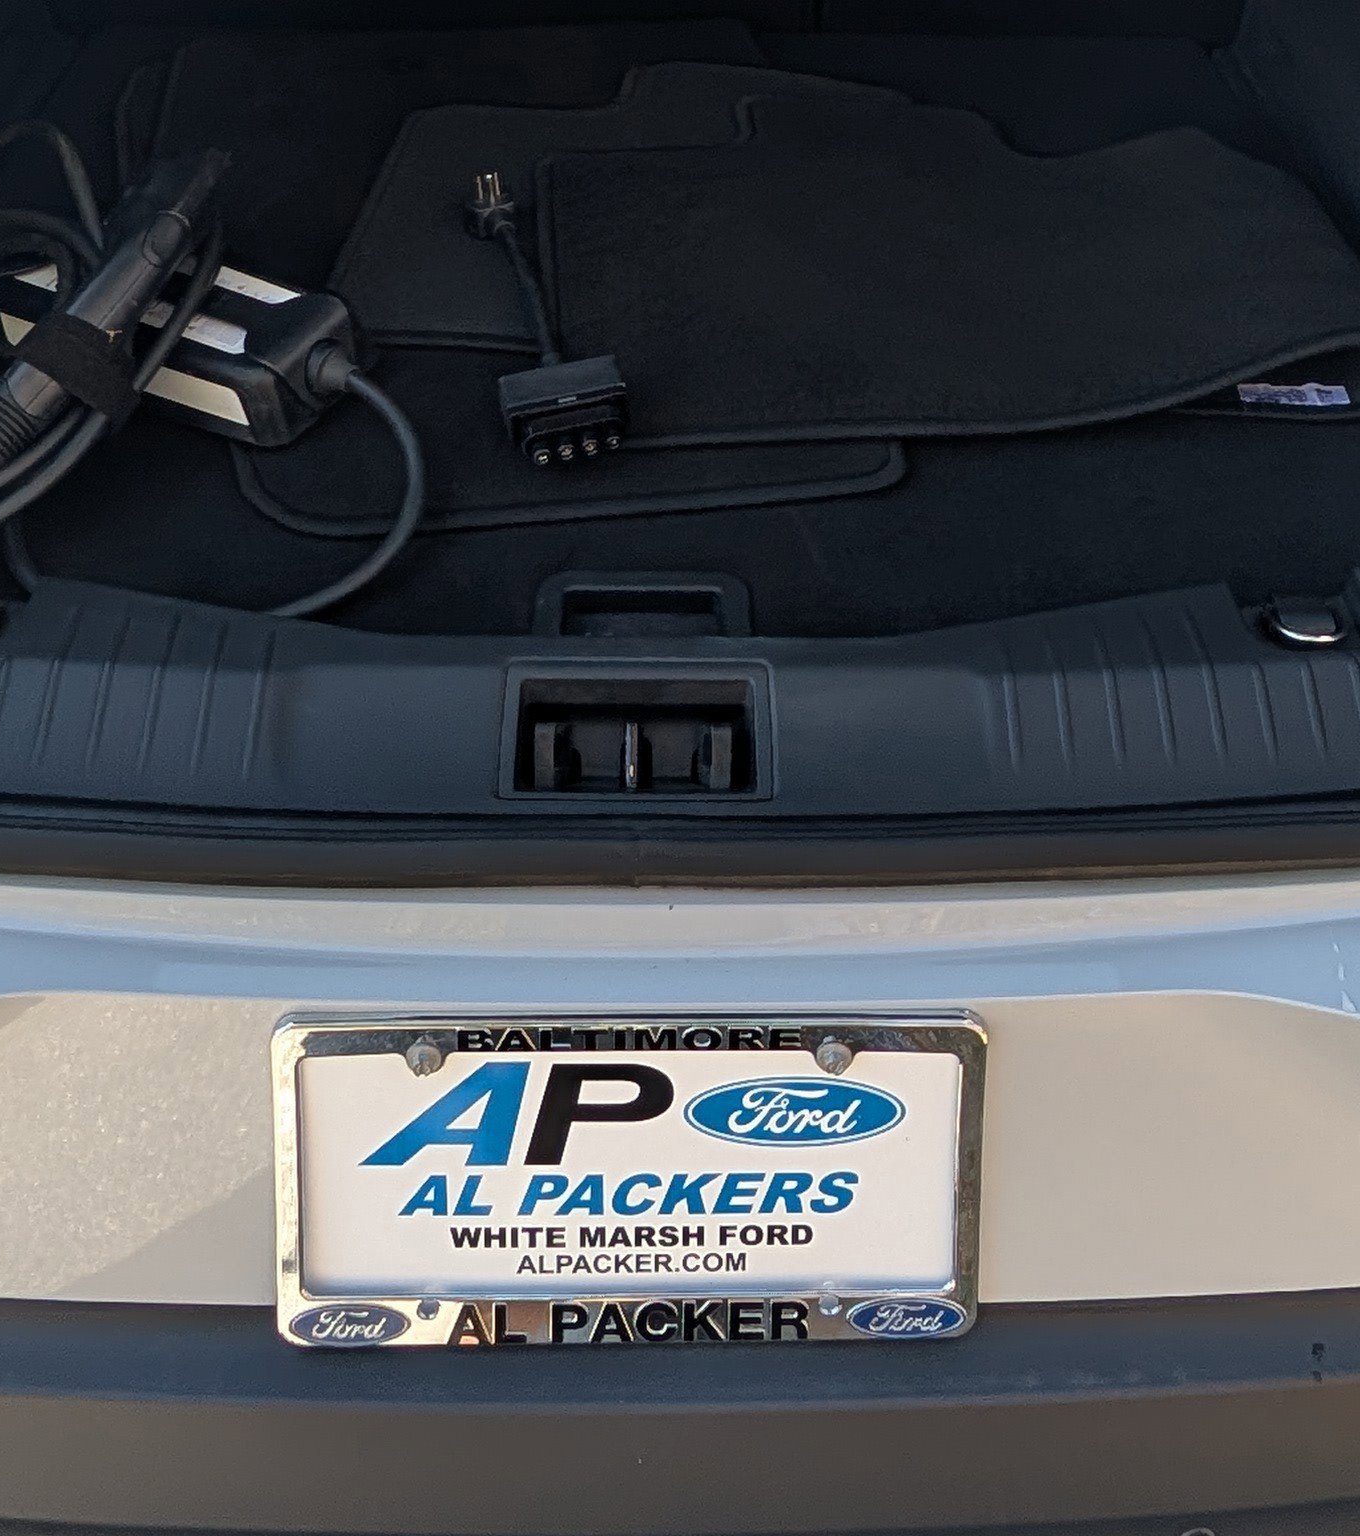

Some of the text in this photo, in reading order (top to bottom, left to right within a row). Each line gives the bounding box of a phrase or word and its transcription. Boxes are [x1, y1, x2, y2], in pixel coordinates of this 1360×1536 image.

[455, 1026, 803, 1051] BALTIMORE
[358, 1061, 674, 1166] AP
[727, 1086, 862, 1136] Ford
[399, 1171, 859, 1217] AL PACKERS
[450, 1225, 814, 1248] WHITE MARSH FORD
[516, 1251, 748, 1275] ALPACKER.COM
[311, 1309, 387, 1340] Ford
[447, 1300, 811, 1345] AL PACKER
[868, 1303, 945, 1332] Ford
